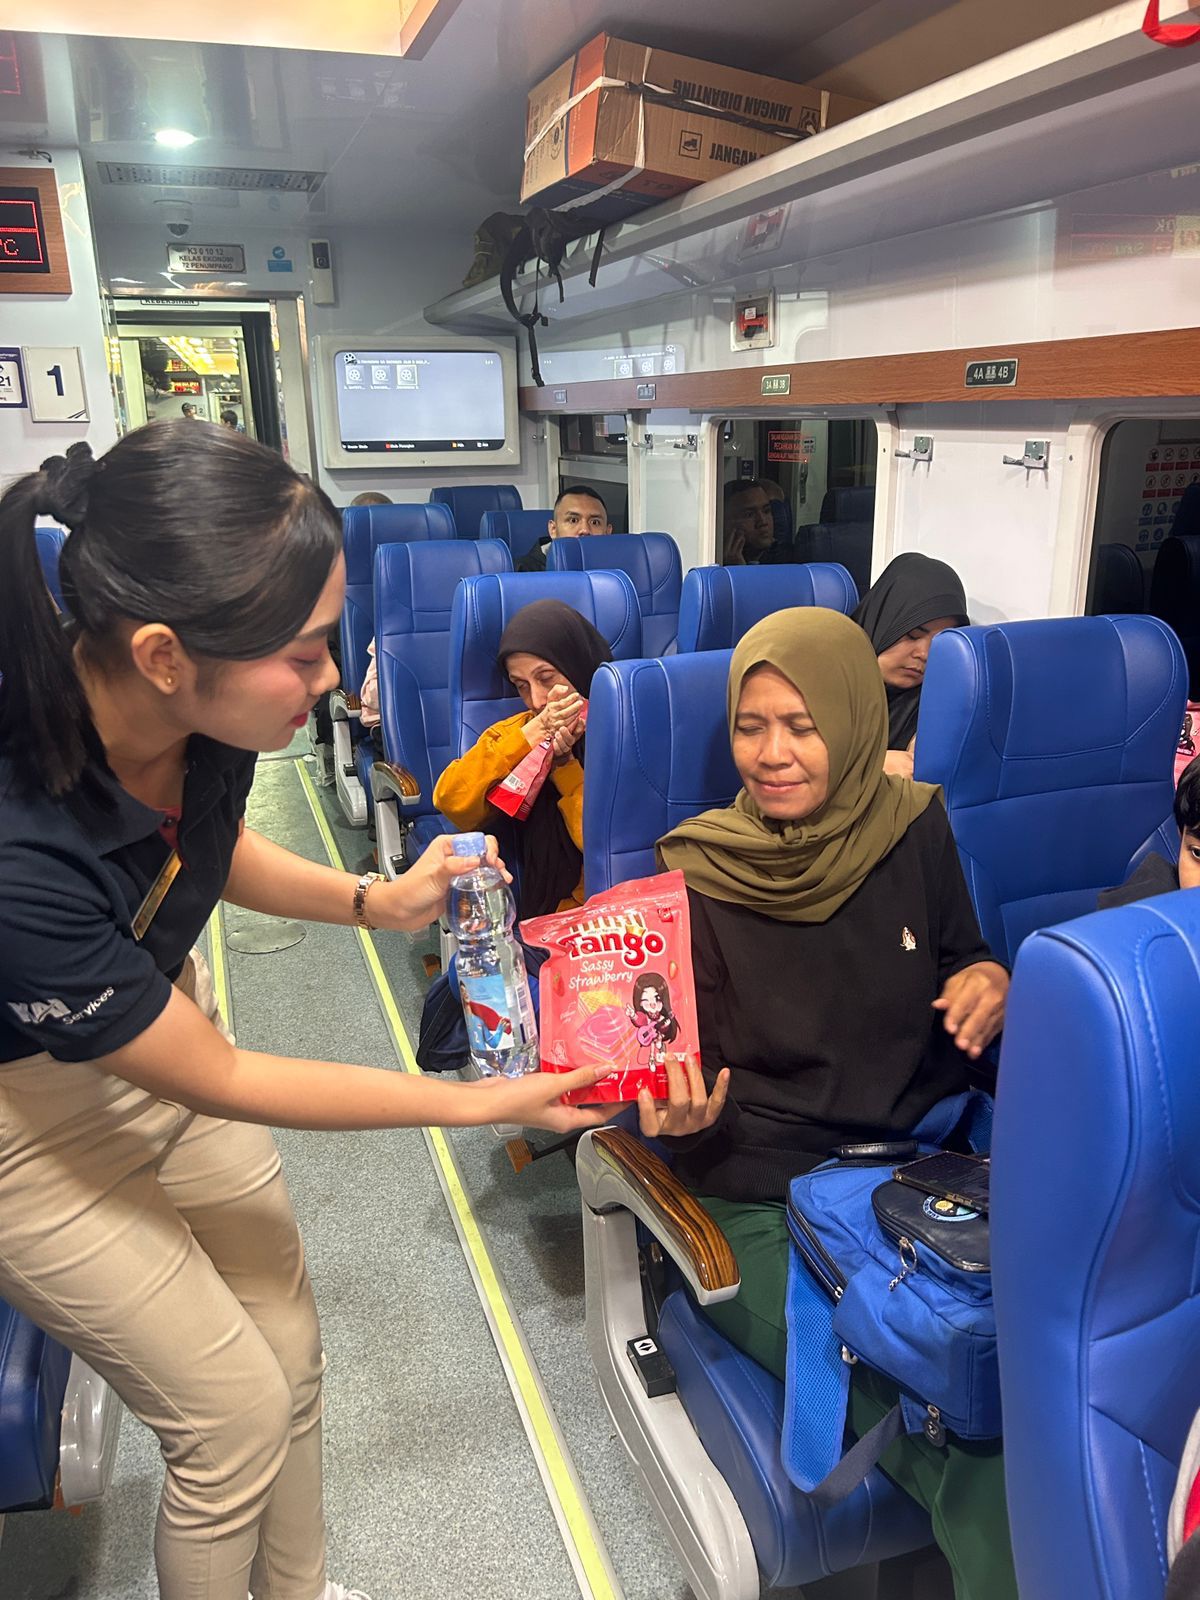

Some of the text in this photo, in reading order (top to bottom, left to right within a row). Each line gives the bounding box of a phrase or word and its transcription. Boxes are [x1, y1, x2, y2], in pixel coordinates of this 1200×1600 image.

[673, 79, 792, 123] JANGAN DIBANTING
[46, 365, 65, 397] 1
[973, 366, 1009, 380] 4A 4B
[557, 930, 666, 968] Tango
[568, 971, 633, 992] Strawberry
[580, 959, 614, 973] Sassy
[62, 986, 115, 1025] Services
